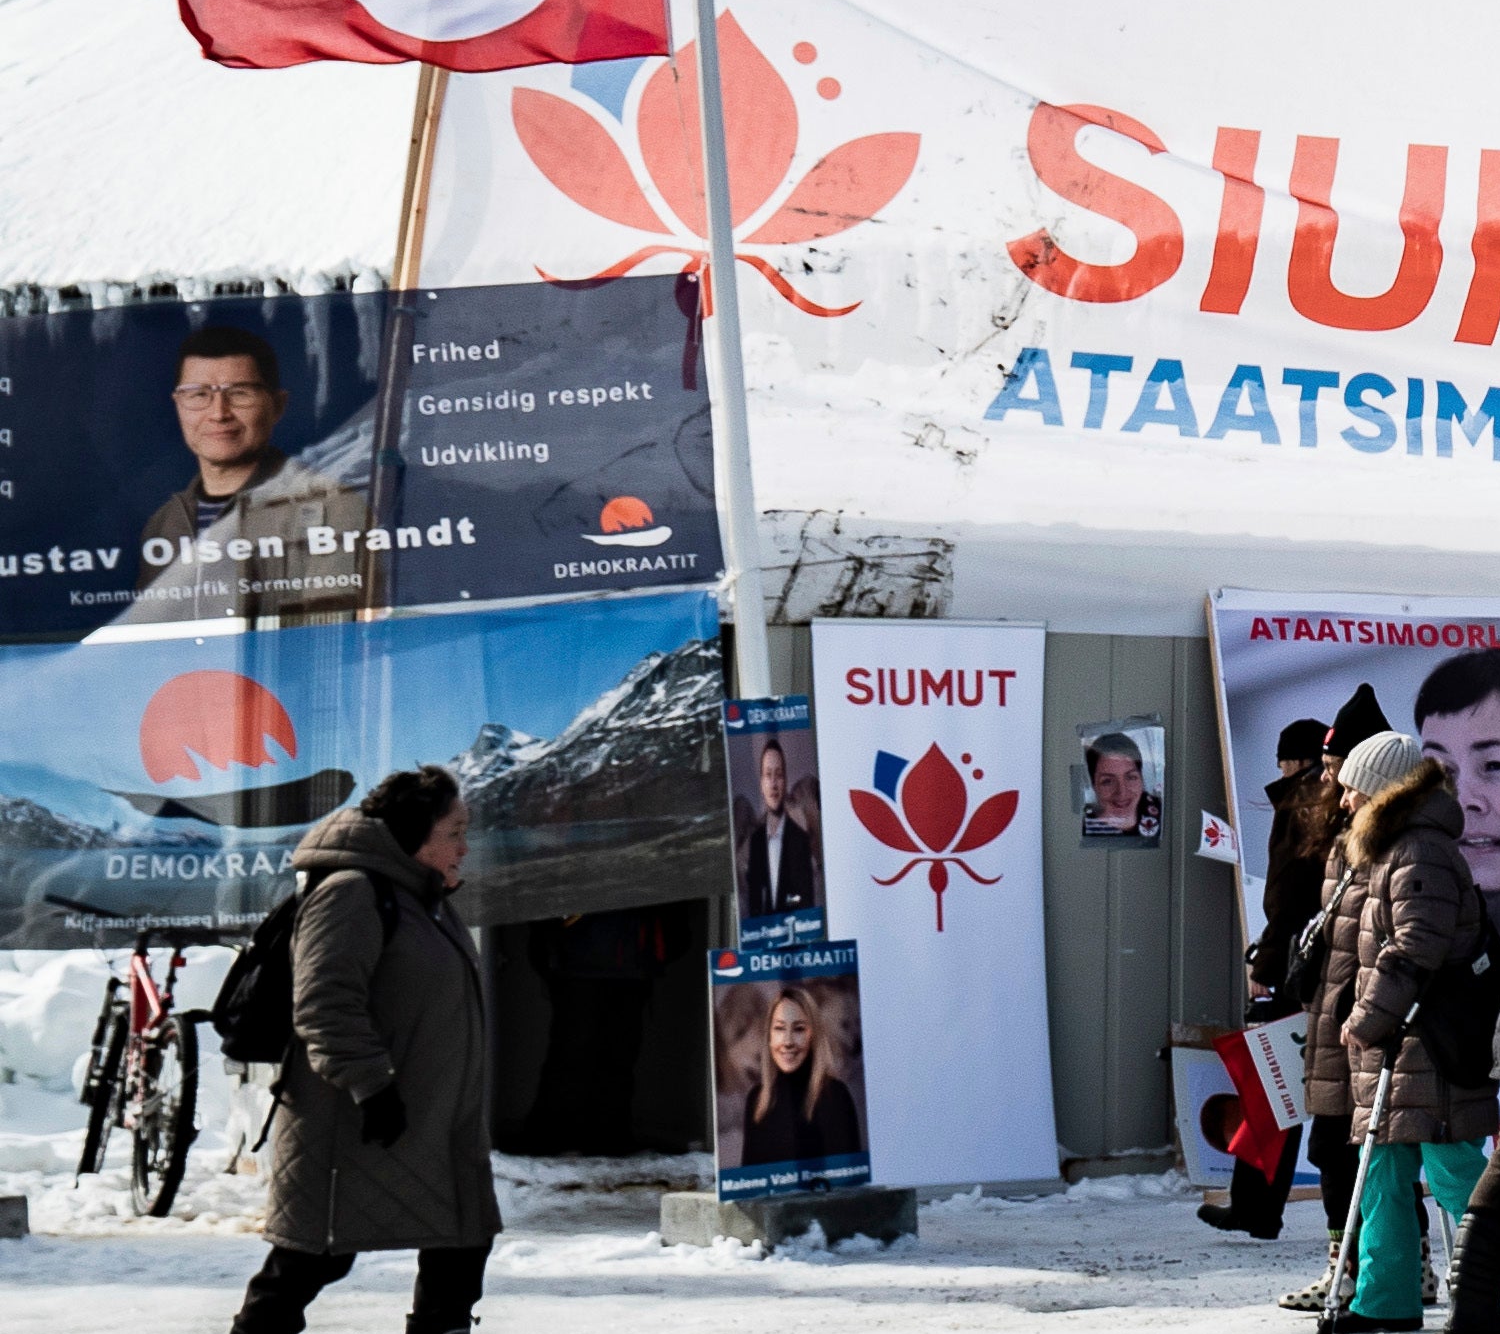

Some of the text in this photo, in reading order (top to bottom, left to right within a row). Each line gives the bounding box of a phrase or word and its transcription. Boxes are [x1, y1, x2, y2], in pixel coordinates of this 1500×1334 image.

[413, 340, 500, 364] Frihed
[418, 381, 654, 415] Gensidig respekt
[421, 441, 550, 466] Udvikling
[142, 534, 284, 567] Olsen
[306, 517, 476, 555] Brandt
[554, 554, 698, 579] DEMOKRAATIT
[69, 573, 363, 606] Kommuneqarfik Sermersooq
[845, 667, 1017, 708] SIUMUT
[751, 948, 856, 972] DEMOKRAATIT
[1257, 1032, 1299, 1120] INUIT ATAQATIGIIT
